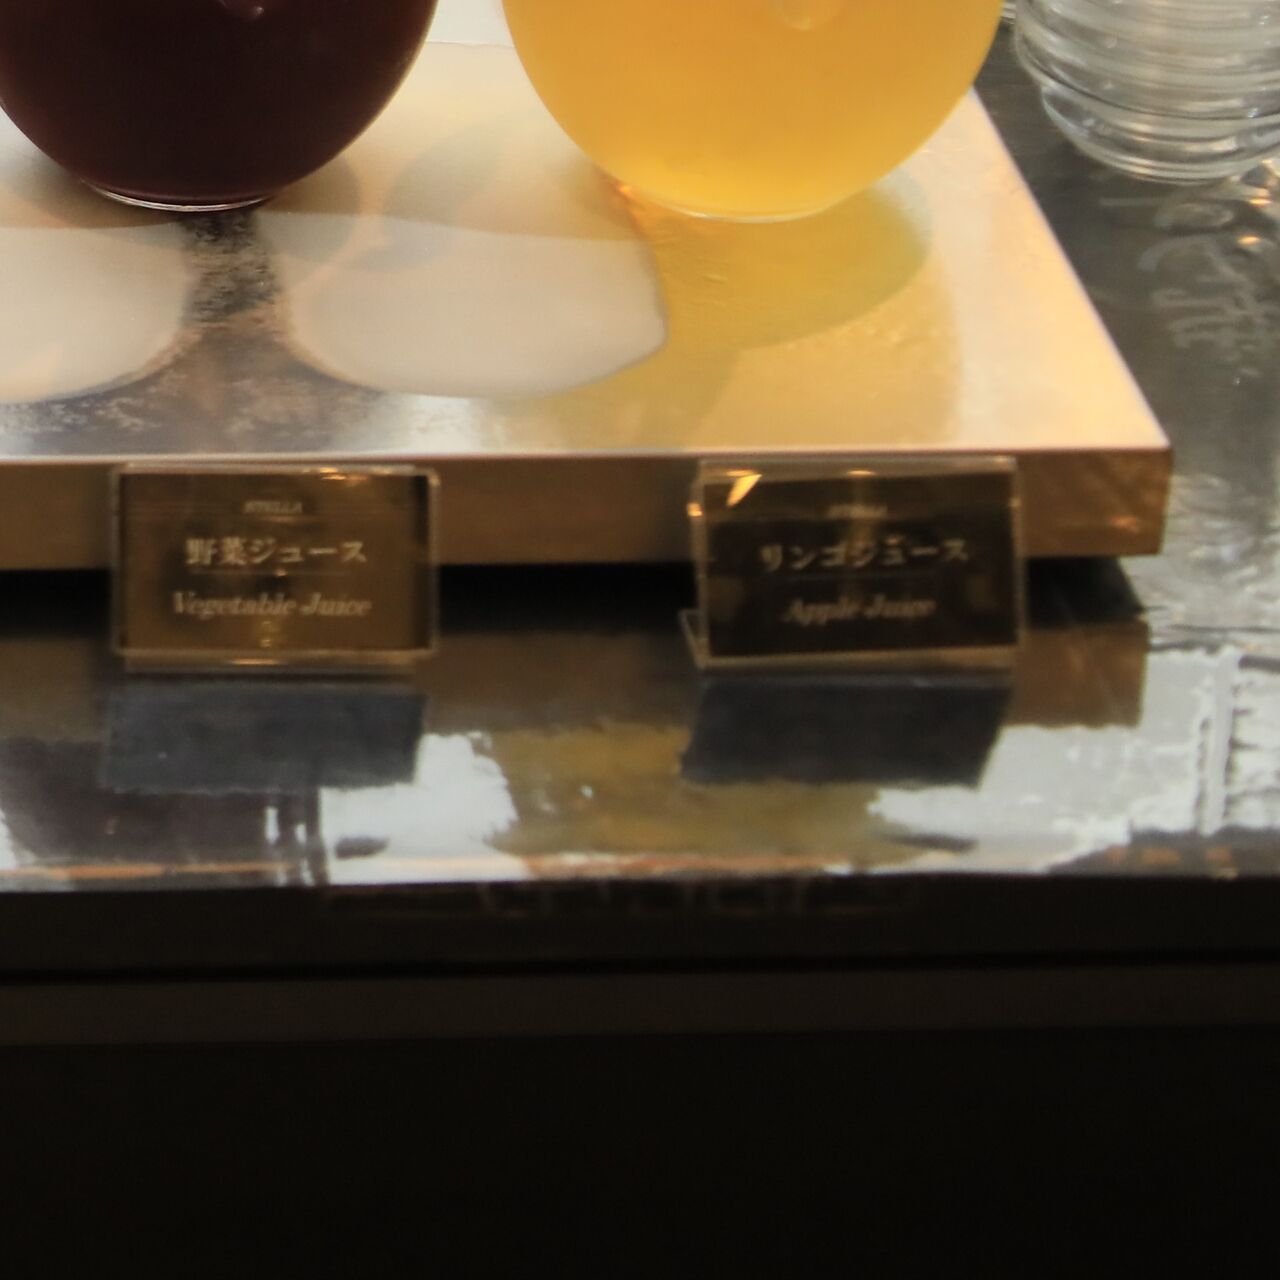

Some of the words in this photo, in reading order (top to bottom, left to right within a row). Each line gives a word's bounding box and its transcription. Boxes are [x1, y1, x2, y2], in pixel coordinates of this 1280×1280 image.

[184, 535, 368, 567] 野菜ジュース
[757, 533, 970, 573] リンゴジュース
[172, 590, 297, 620] Vegetable
[298, 591, 372, 618] Juice
[779, 595, 861, 627] Apple
[862, 593, 938, 619] Juice
